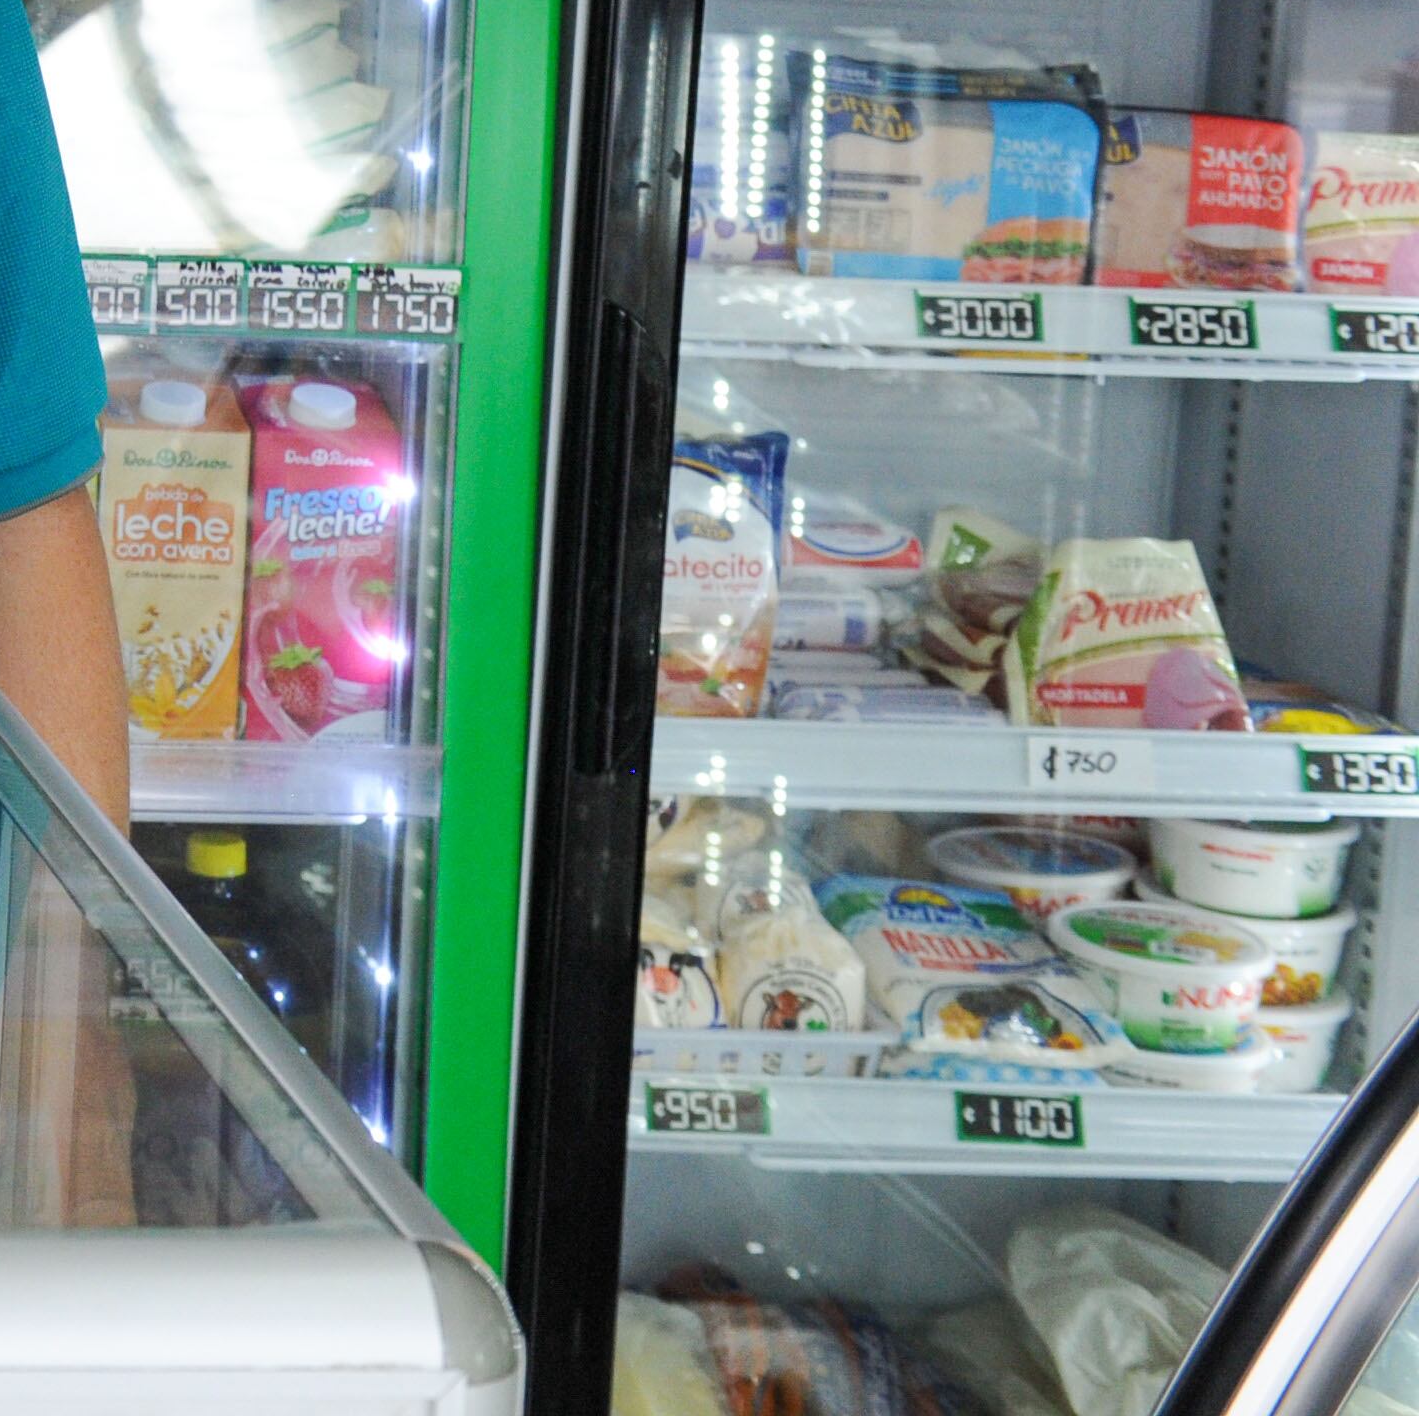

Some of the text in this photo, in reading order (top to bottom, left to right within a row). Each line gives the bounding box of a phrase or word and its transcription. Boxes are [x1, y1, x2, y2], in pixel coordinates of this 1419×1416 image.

[1200, 146, 1287, 171] JAMÓN
[1228, 174, 1287, 191] PAVO
[1199, 193, 1283, 210] AHUMADO
[373, 296, 454, 333] 1750
[923, 298, 1032, 339] ¢3000
[1139, 307, 1248, 346] ¢2850
[1337, 314, 1419, 352] ¢120
[265, 485, 383, 520] Fresco
[119, 502, 229, 543] leche
[289, 500, 392, 542] leche!
[116, 543, 230, 561] con avena
[662, 555, 763, 579] atecito
[882, 928, 1008, 962] NATILLA
